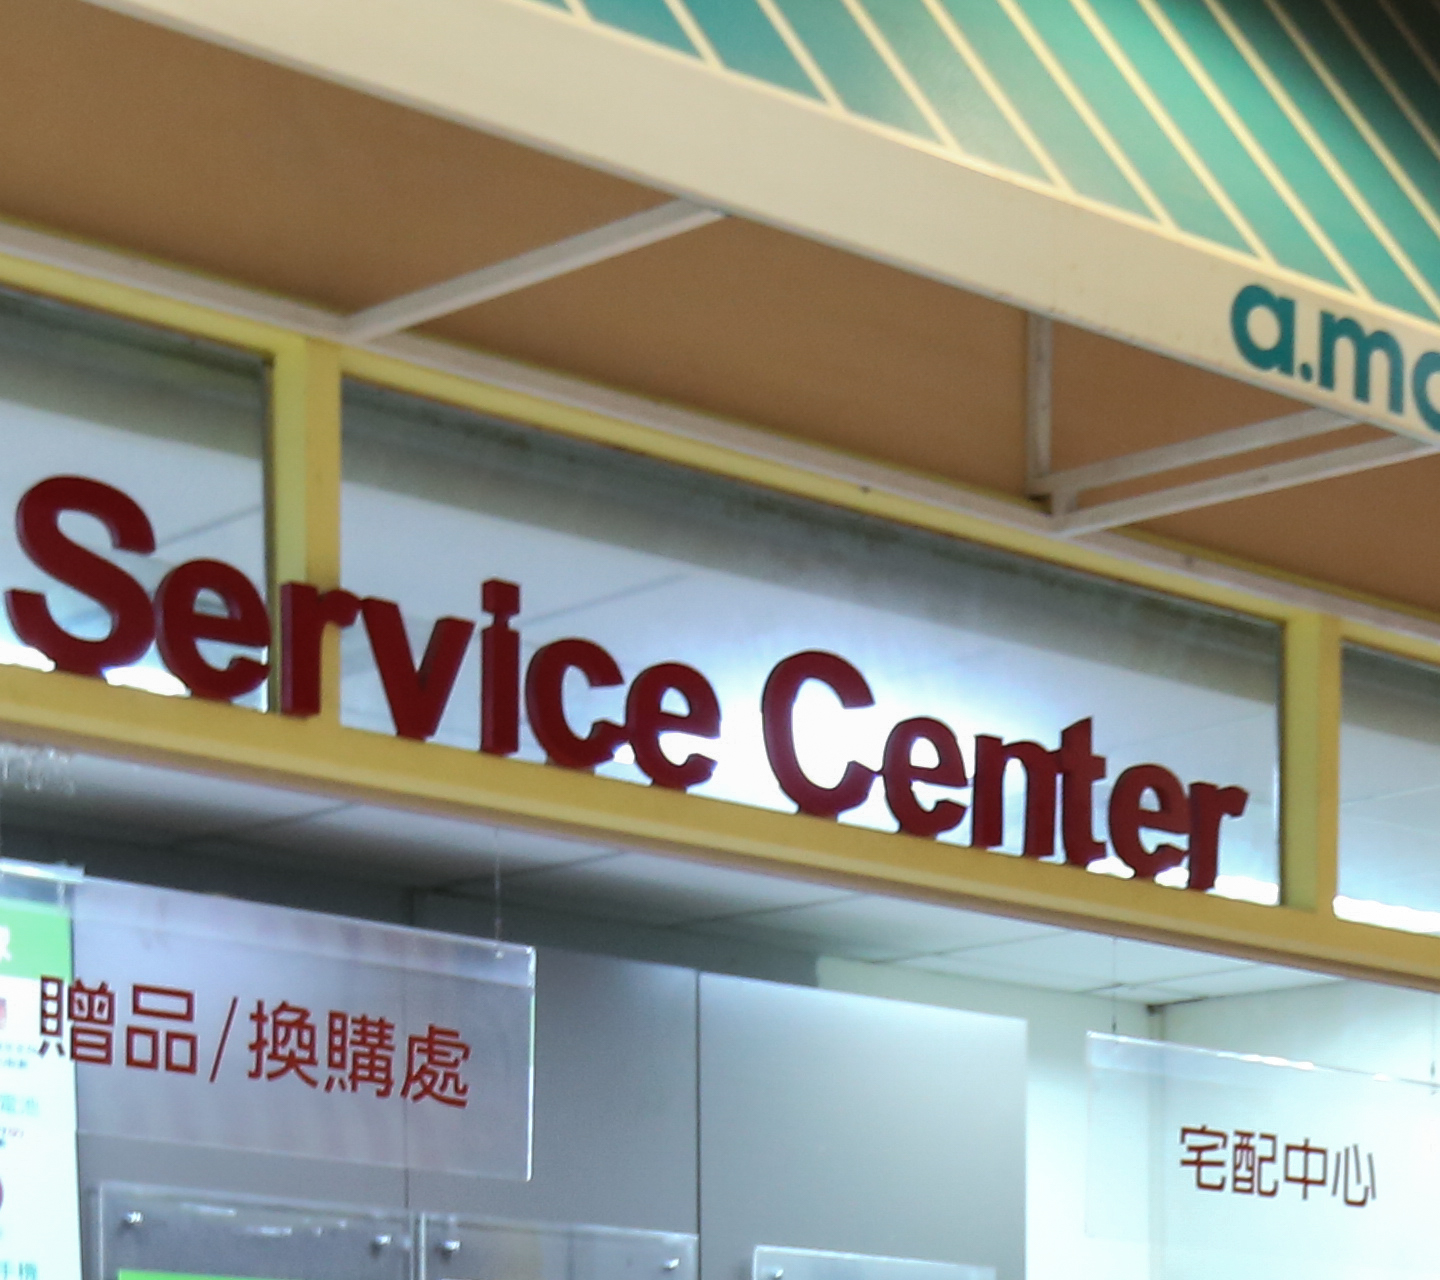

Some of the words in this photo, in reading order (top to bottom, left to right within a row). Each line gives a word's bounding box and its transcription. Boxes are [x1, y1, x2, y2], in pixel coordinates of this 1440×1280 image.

[4, 475, 723, 787] Service
[760, 648, 1250, 895] Center
[37, 974, 471, 1109] 贈品/換購處
[1178, 1123, 1377, 1209] 宅配中心
